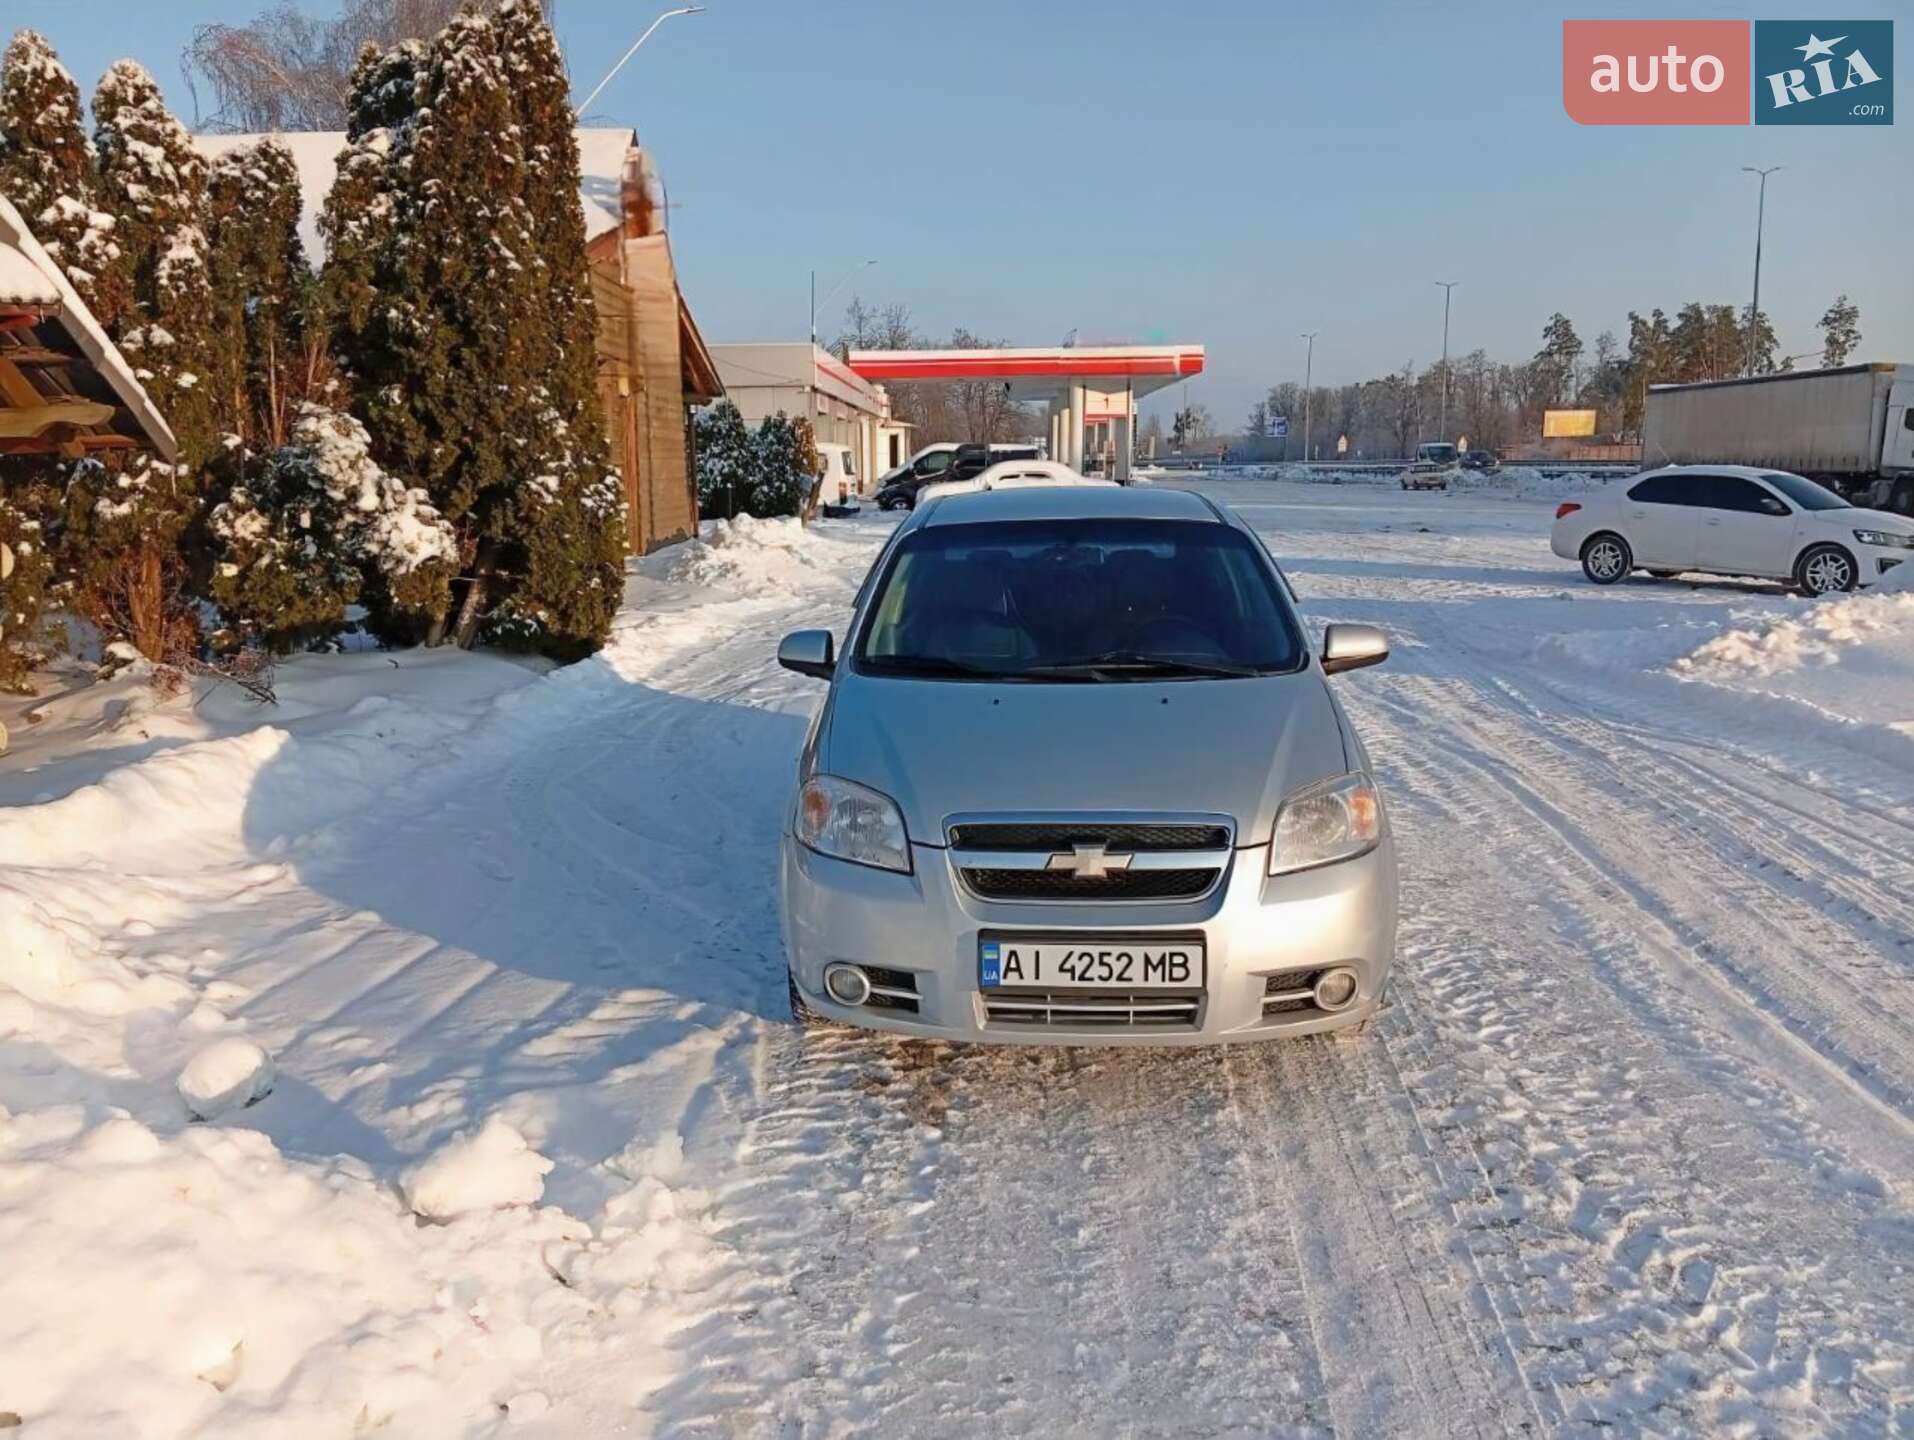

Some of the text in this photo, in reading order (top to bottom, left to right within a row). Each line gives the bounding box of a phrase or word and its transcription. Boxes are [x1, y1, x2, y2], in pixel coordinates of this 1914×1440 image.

[984, 970, 998, 980] UA
[1002, 950, 1190, 983] AI 4252 MB
